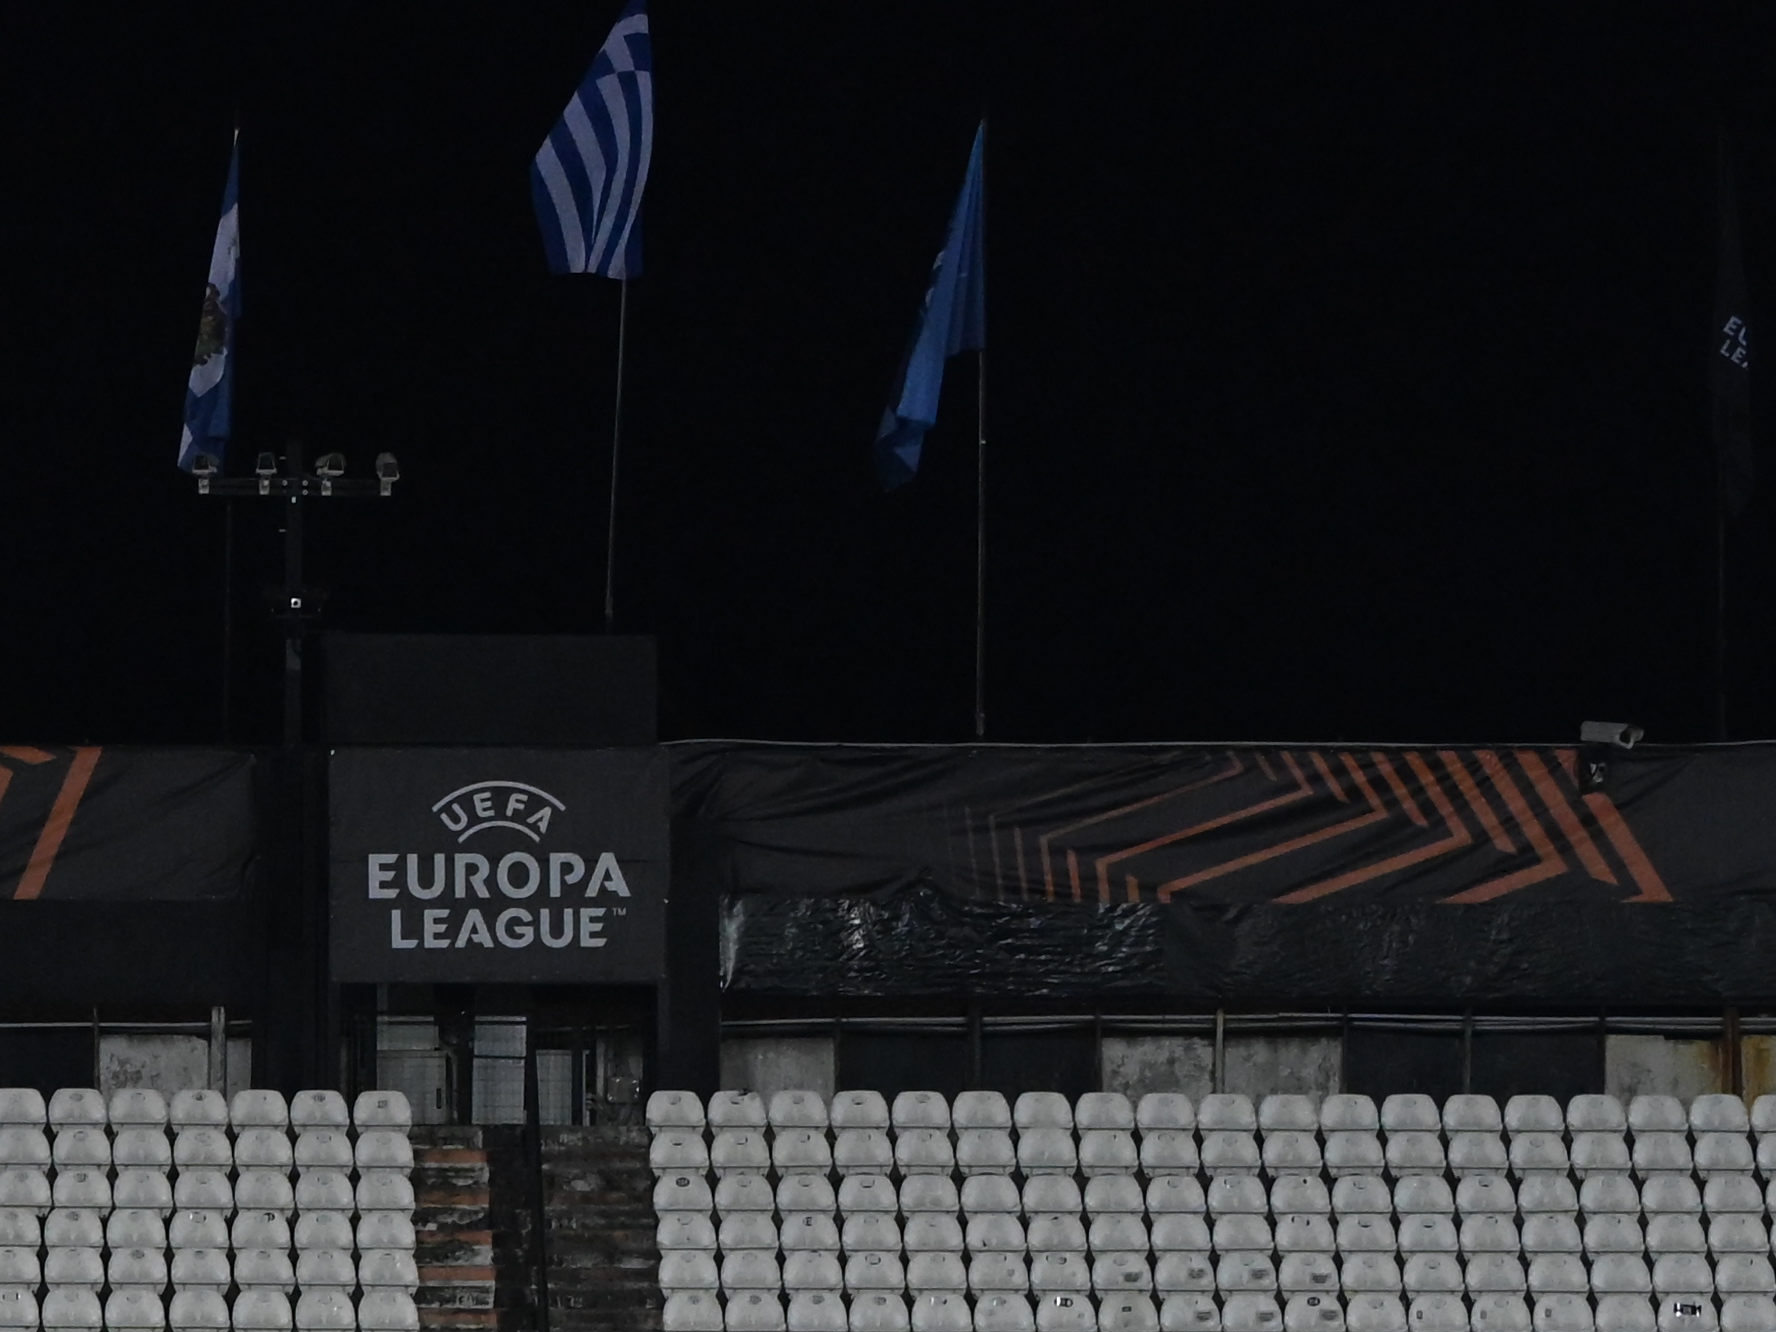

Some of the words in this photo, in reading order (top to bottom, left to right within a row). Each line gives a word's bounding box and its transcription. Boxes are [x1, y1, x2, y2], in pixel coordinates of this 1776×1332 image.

[440, 791, 553, 834] UEFA
[368, 851, 631, 900] EUROPA
[391, 907, 608, 949] LEAGUE
